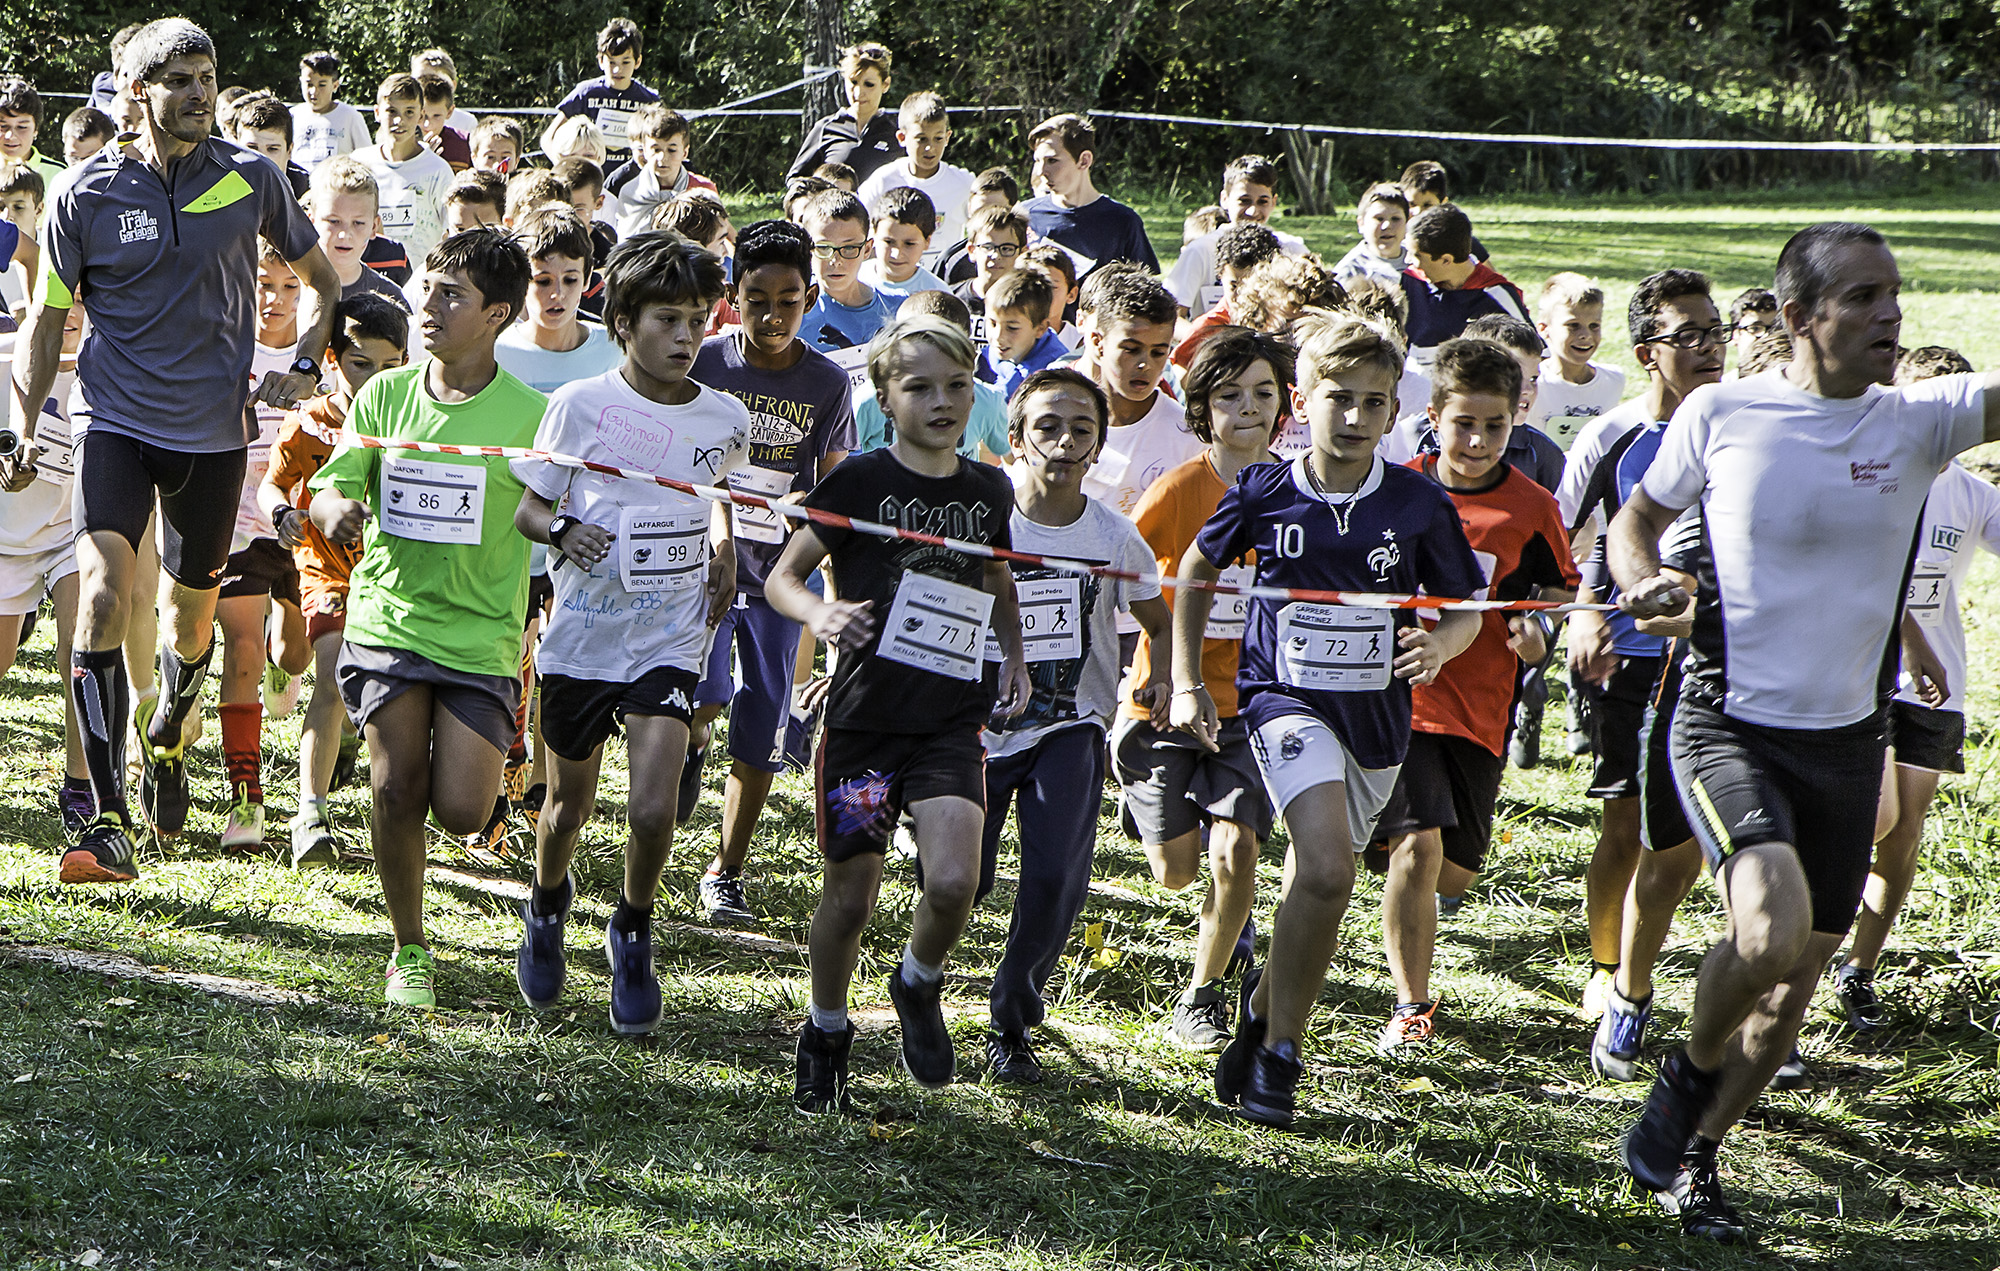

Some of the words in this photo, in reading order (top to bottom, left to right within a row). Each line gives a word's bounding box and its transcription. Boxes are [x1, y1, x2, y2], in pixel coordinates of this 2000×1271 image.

[587, 98, 608, 109] BLAH
[613, 125, 626, 133] 104
[117, 210, 149, 231] Trail
[381, 212, 394, 221] 89
[119, 226, 158, 241] Garlaban
[769, 418, 792, 433] 12-8
[758, 445, 798, 461] HIRE
[60, 453, 74, 467] 5
[418, 492, 440, 510] 86
[633, 520, 675, 529] LAFFARGUE
[1273, 523, 1304, 558] 10
[667, 544, 688, 562] 99
[631, 579, 654, 587] BENJA
[922, 591, 948, 604] HAUTE
[1045, 588, 1063, 596] Pedro
[1295, 613, 1333, 625] MARTINEZ
[938, 624, 960, 645] 77
[984, 643, 1001, 652] ENJA
[1325, 639, 1348, 657] 72
[1311, 670, 1319, 678] M
